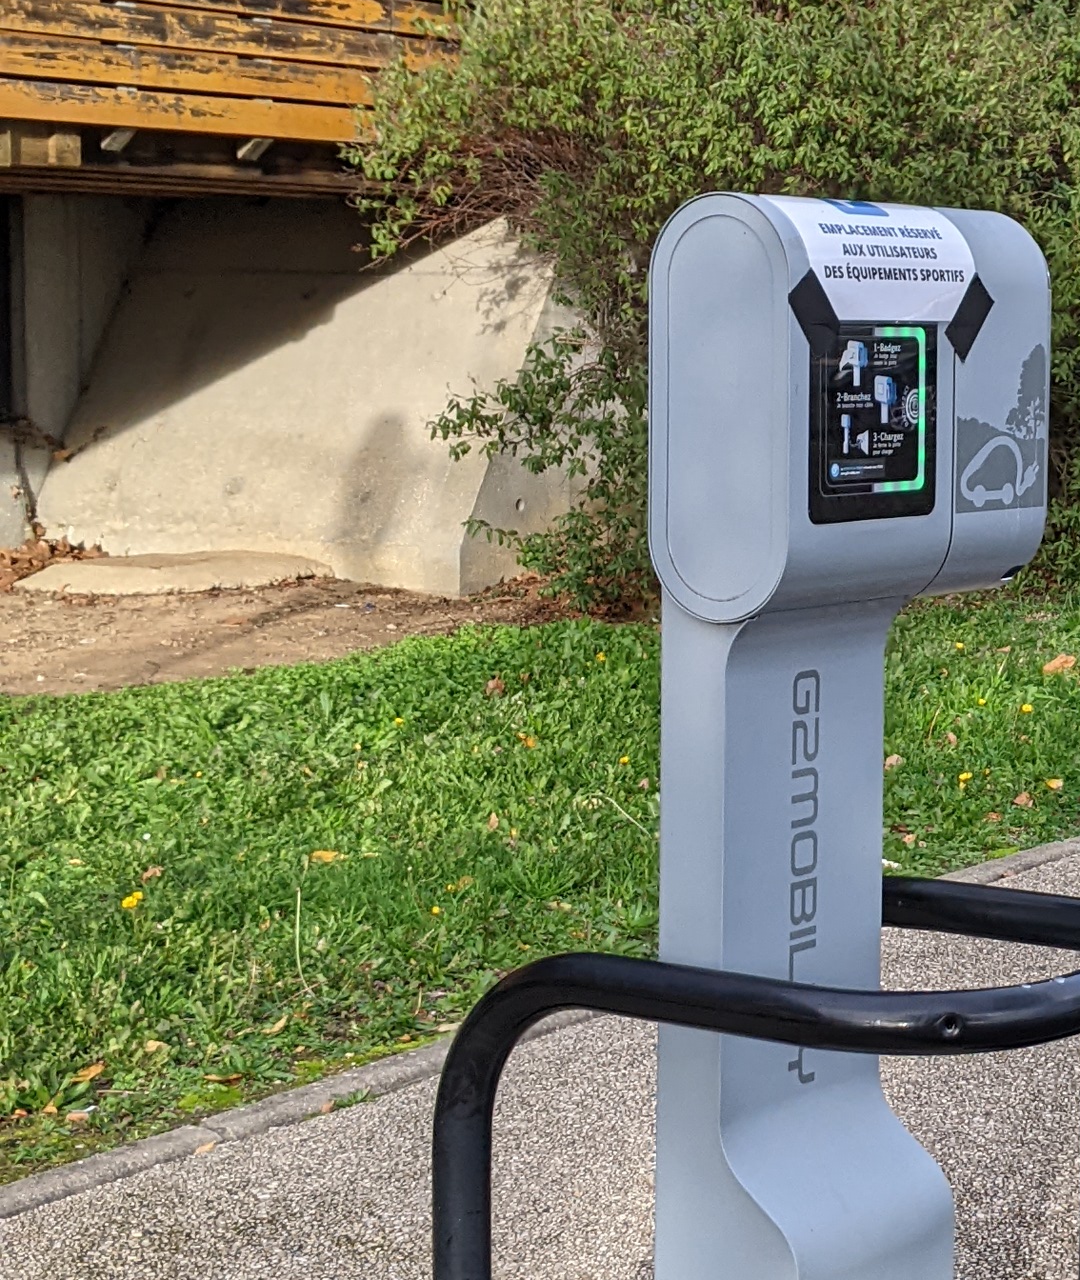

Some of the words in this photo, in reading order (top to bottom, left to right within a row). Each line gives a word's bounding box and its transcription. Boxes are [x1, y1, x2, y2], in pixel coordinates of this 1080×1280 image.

[818, 223, 899, 238] EMPLACEMENT
[899, 225, 943, 240] RÉSERVÉ
[842, 243, 867, 257] AUX
[867, 245, 938, 260] UTILISATEURS
[824, 265, 844, 279] DES
[846, 262, 919, 282] ÉQUIPEMENTS
[920, 269, 965, 283] SPORTIFS
[787, 668, 820, 1085] G2MOBILY
